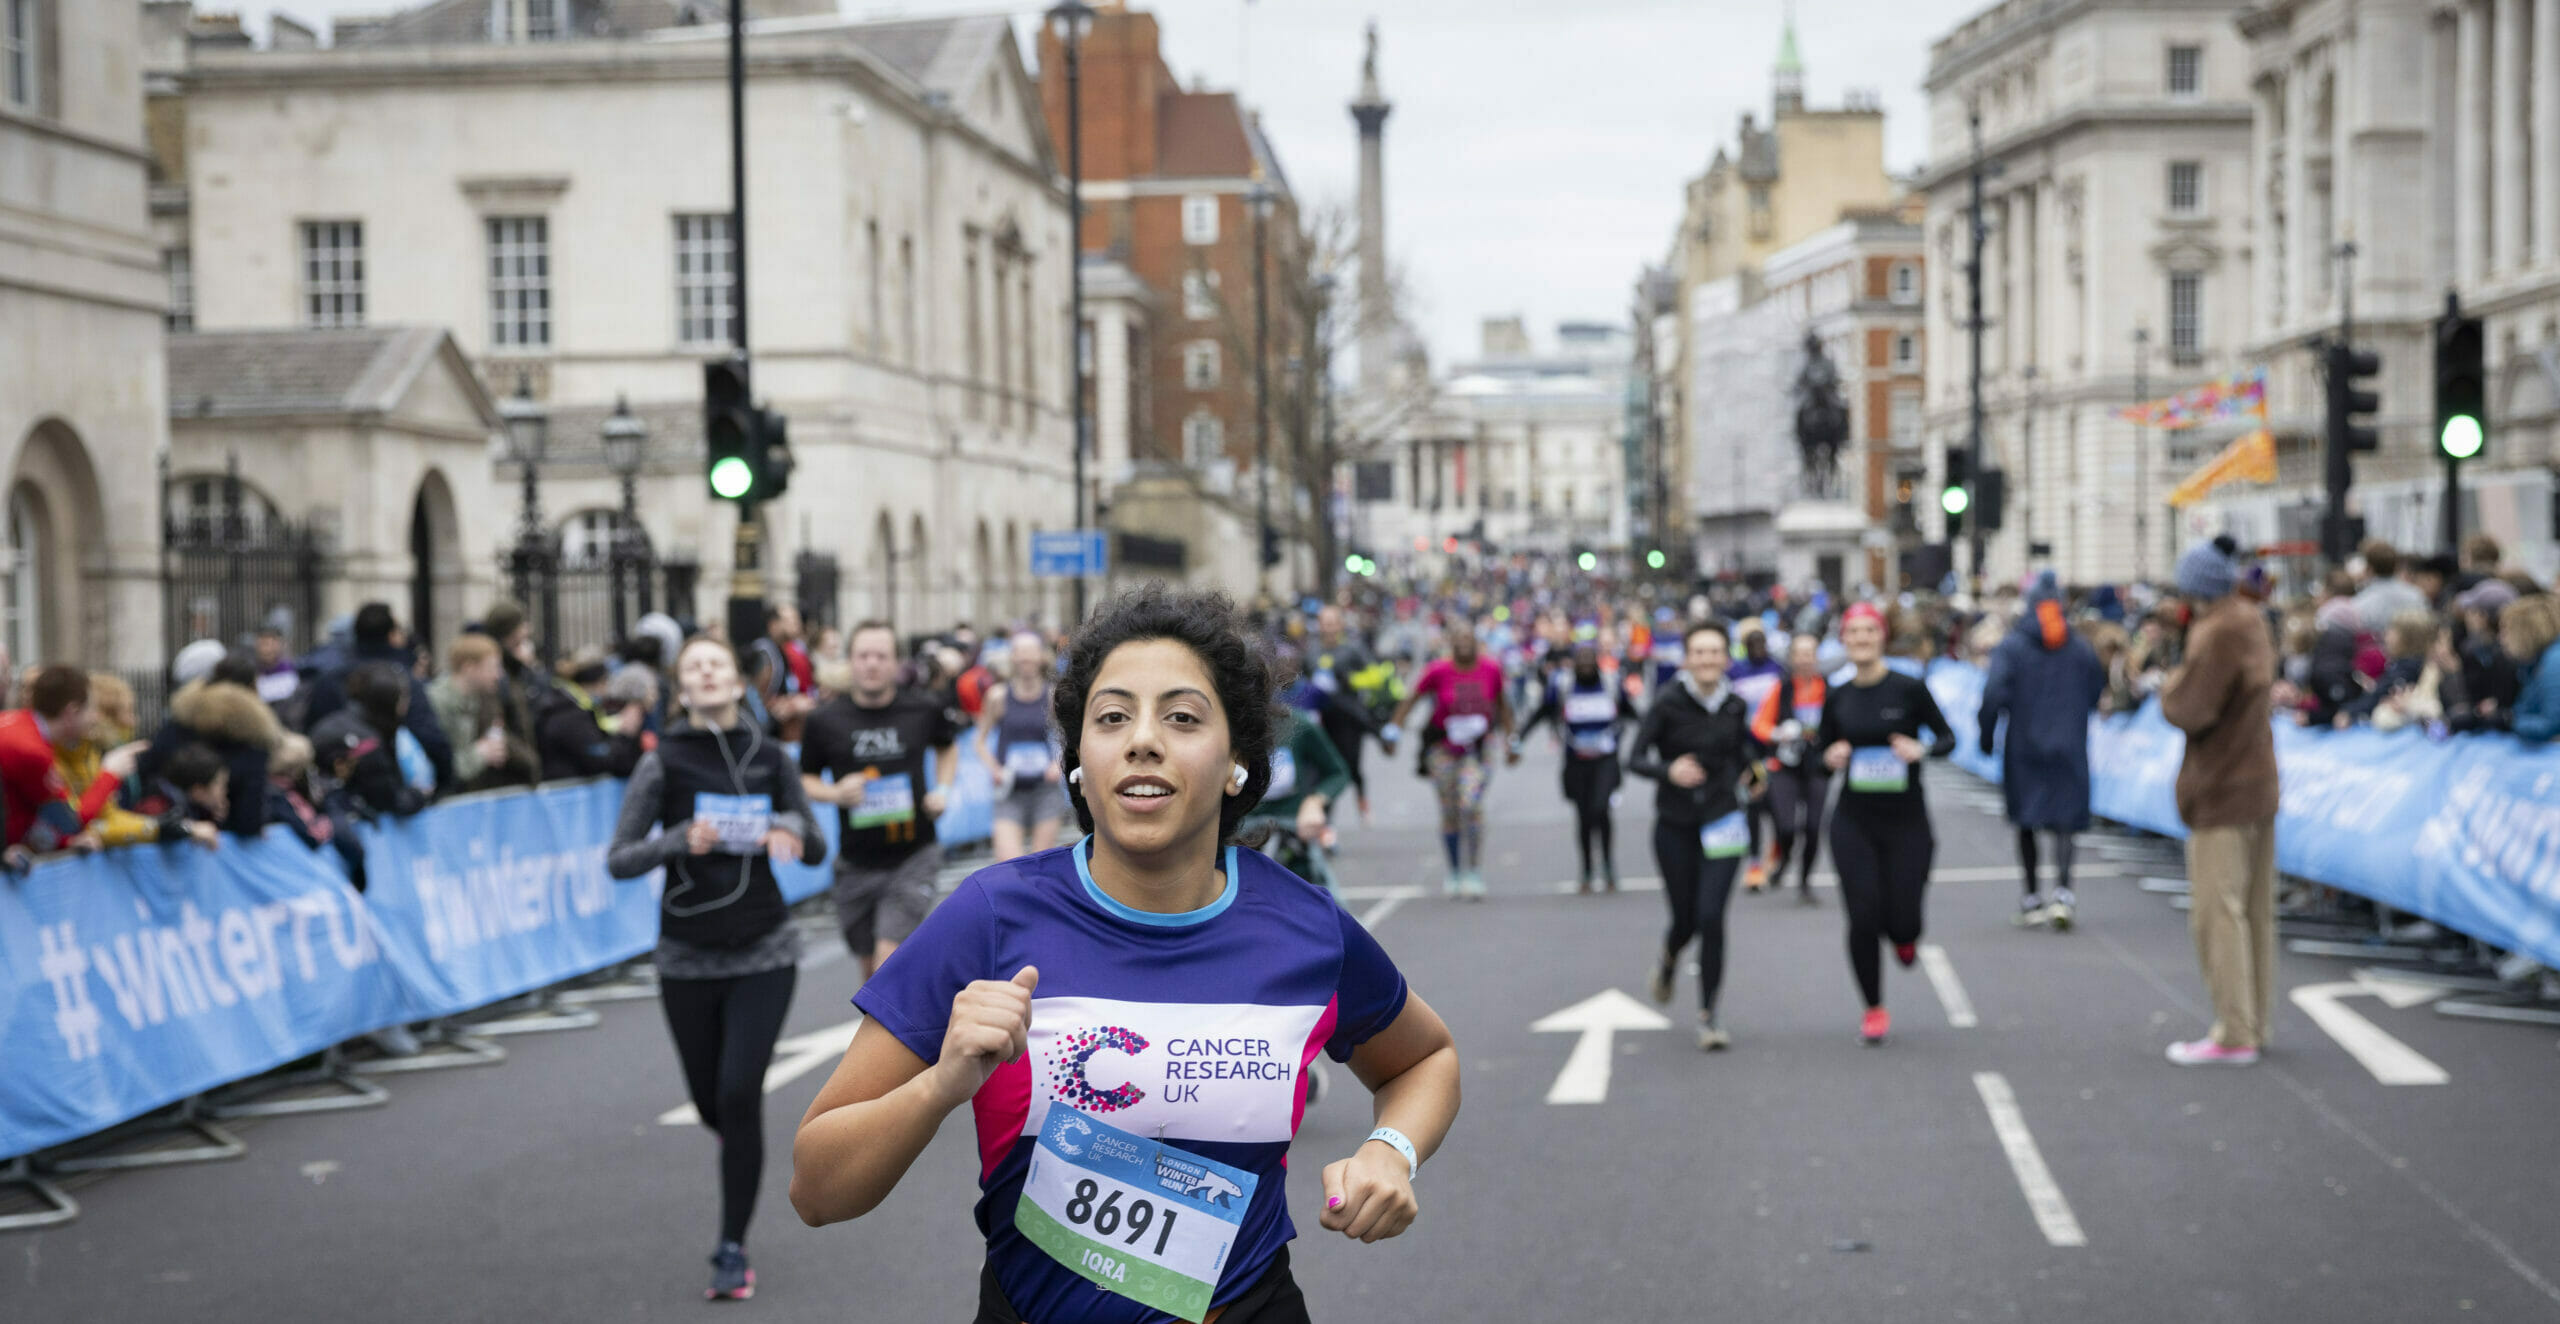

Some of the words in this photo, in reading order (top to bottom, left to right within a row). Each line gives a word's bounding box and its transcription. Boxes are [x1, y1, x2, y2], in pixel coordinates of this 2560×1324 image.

[39, 887, 380, 1063] #winterru
[1167, 1038, 1271, 1057] CANCER
[1165, 1060, 1291, 1081] RESEARCH
[1163, 1084, 1200, 1103] UK
[1096, 1133, 1138, 1153] CANCER
[1088, 1150, 1104, 1162] UK
[1091, 1142, 1144, 1165] RESEARCH
[1157, 1165, 1198, 1187] WINTER
[1161, 1156, 1201, 1176] LONDON
[1160, 1178, 1185, 1193] RUN
[1065, 1178, 1178, 1257] 8691
[1081, 1248, 1128, 1284] IQRA
